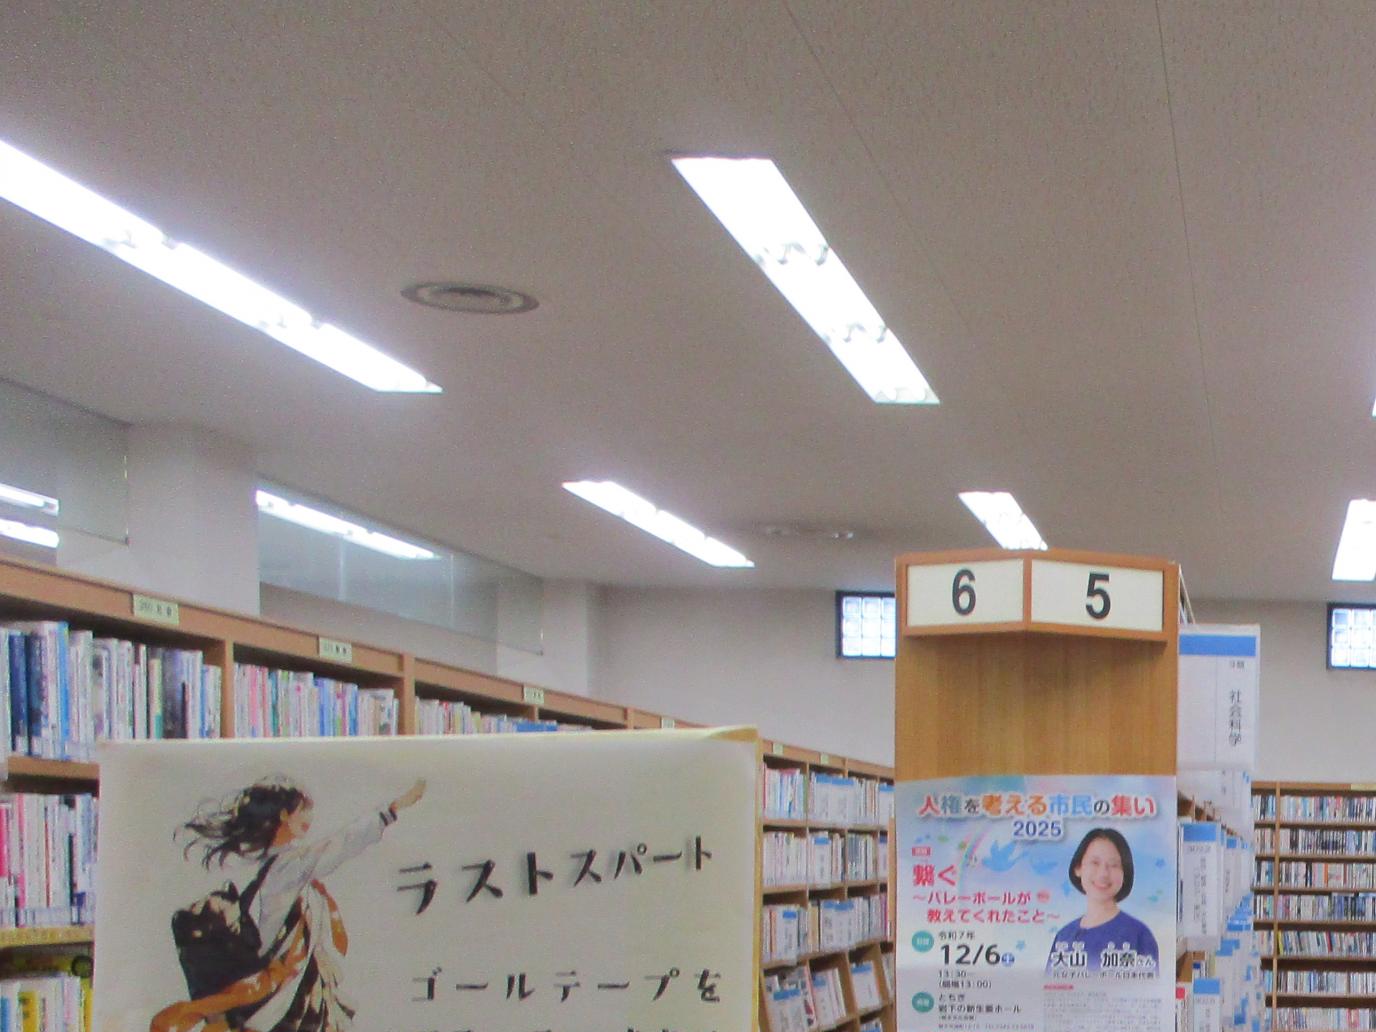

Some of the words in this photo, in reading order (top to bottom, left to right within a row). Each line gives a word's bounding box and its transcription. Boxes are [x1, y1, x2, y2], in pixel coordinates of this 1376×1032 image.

[950, 570, 976, 616] 6
[1085, 572, 1112, 620] 5
[1229, 690, 1242, 747] 社会科学
[918, 793, 1157, 817] 人権を考える市民の集い
[1013, 821, 1062, 837] 2025
[397, 837, 713, 915] ラストスパート
[913, 864, 956, 886] 繋ぐ
[941, 944, 1000, 966] 12/6
[1052, 952, 1086, 967] 大山
[411, 967, 722, 1004] ゴールテープを
